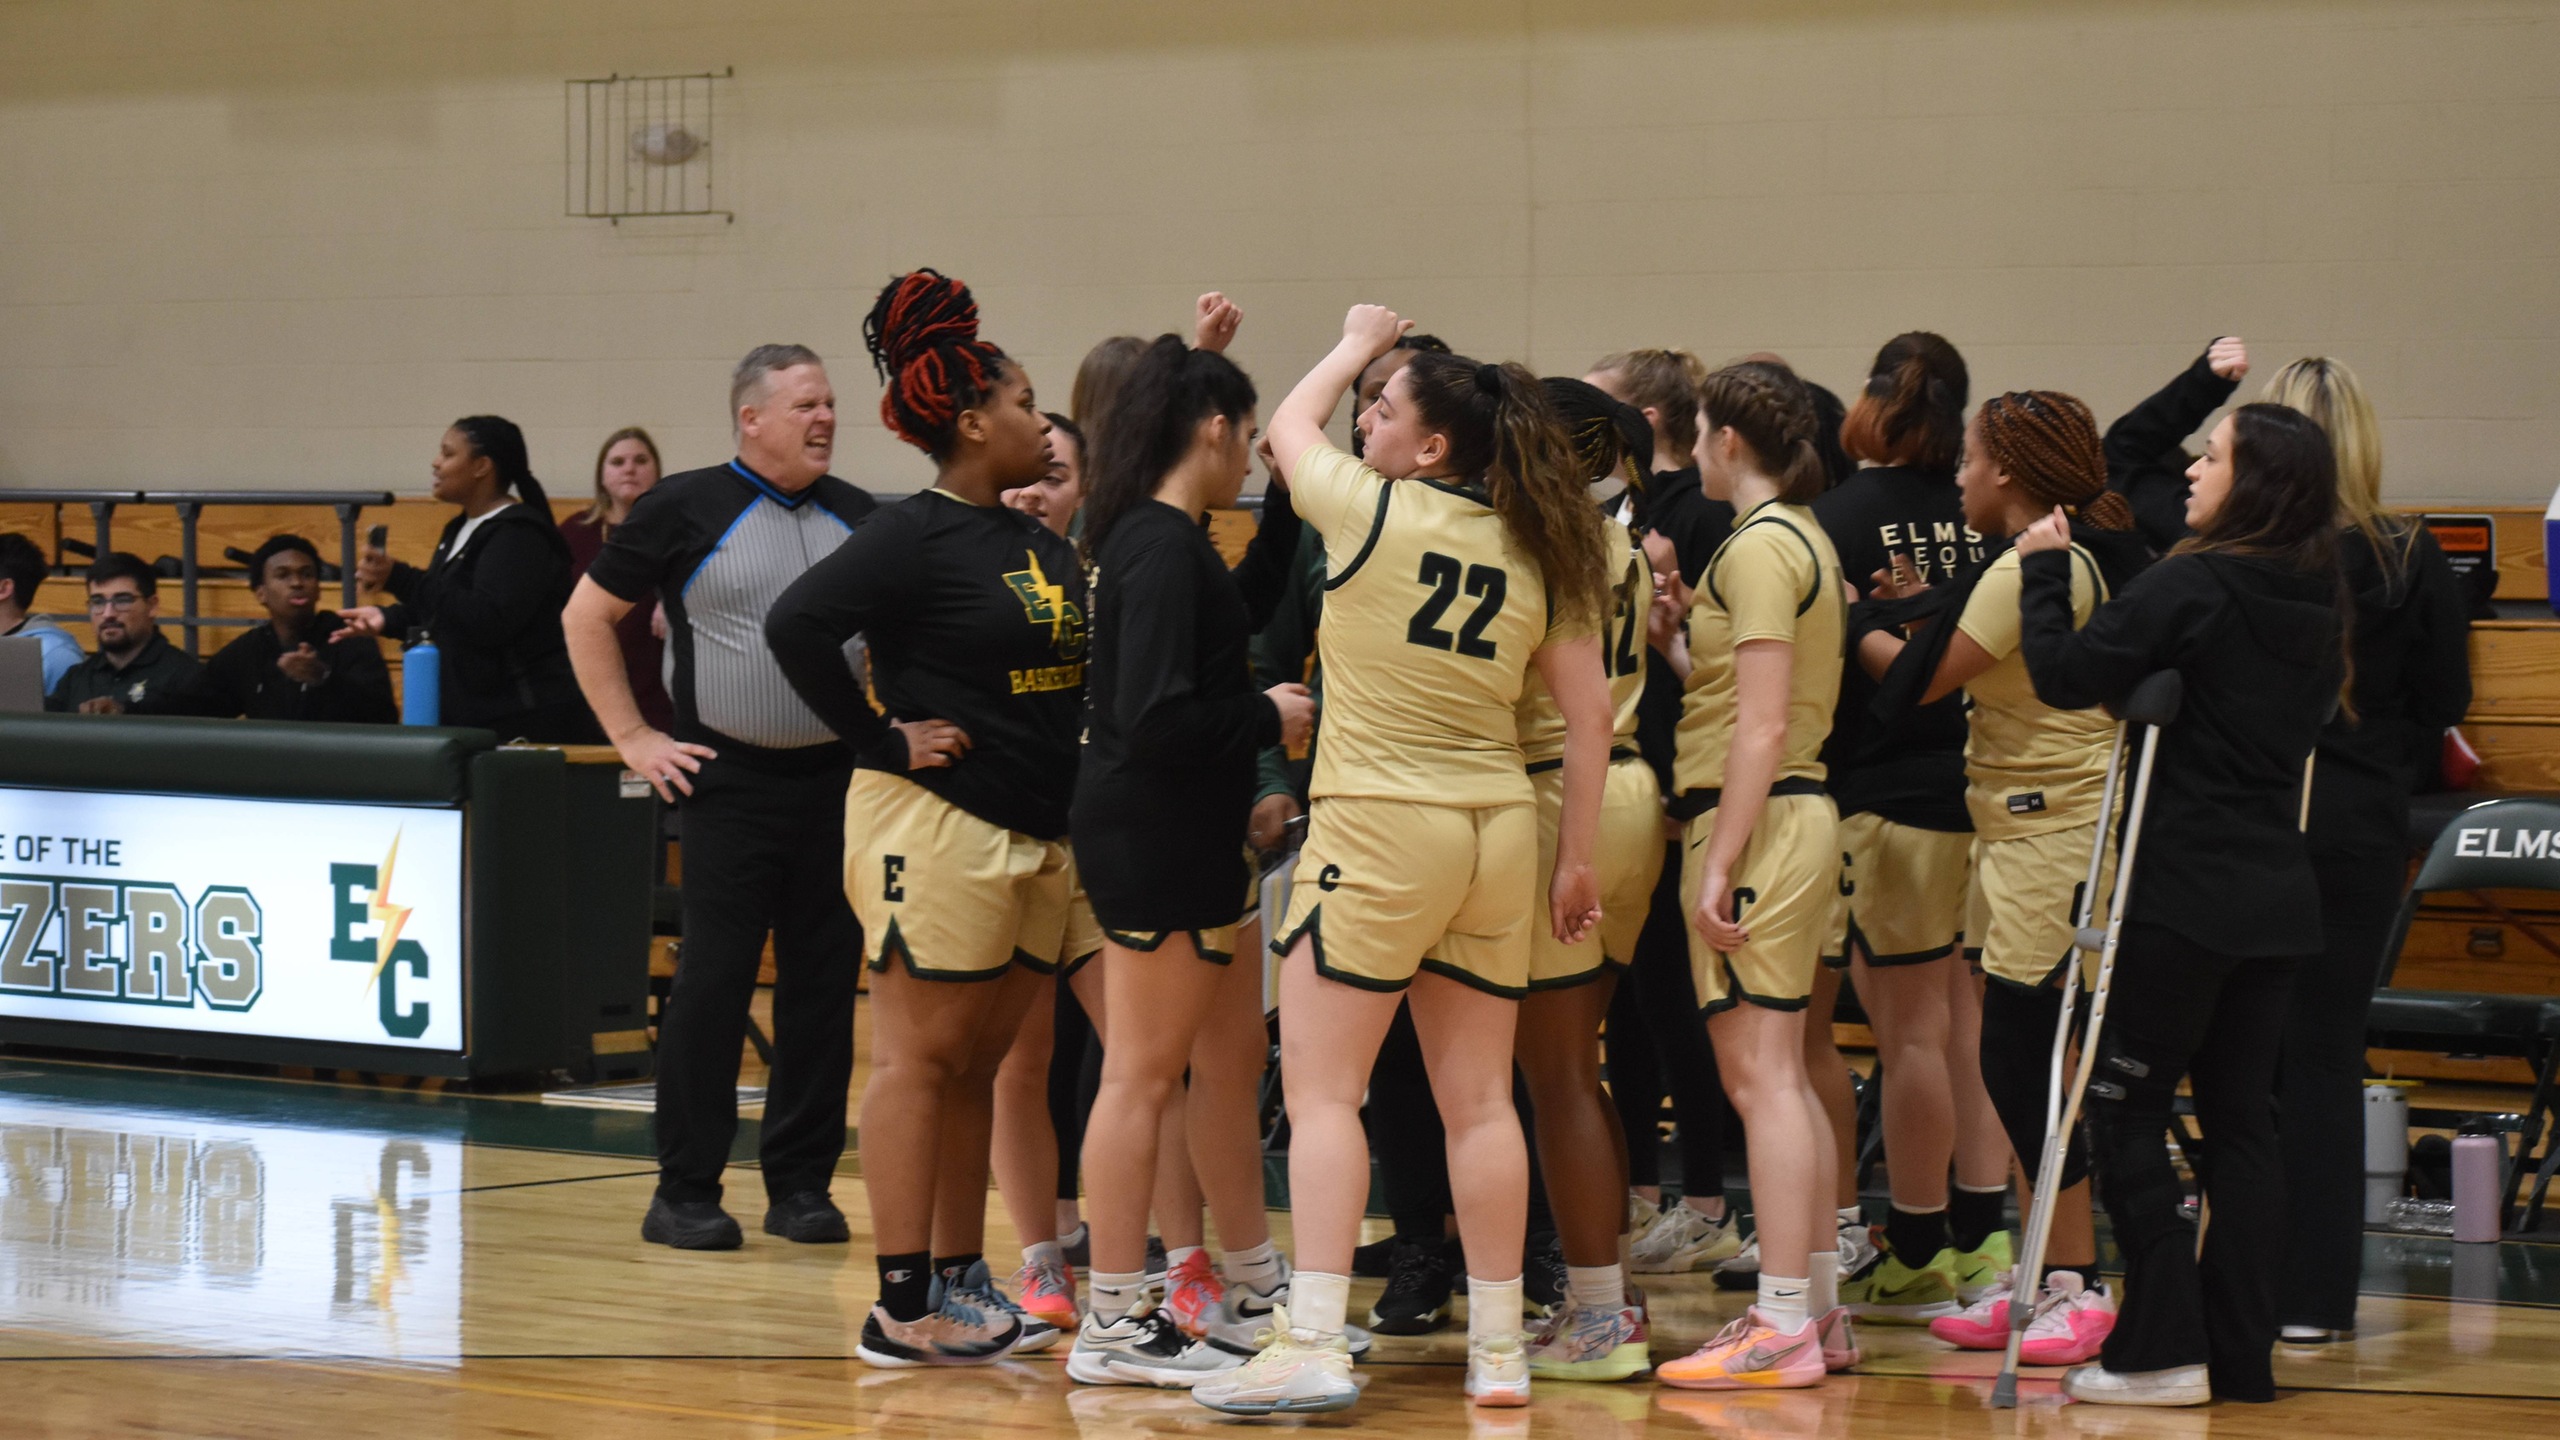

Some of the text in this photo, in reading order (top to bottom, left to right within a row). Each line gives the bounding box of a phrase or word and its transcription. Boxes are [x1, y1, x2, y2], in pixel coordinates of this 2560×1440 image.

[1879, 522, 1983, 546] ELMS
[1406, 551, 1507, 661] 22
[16, 835, 52, 862] OF
[63, 837, 121, 867] THE
[2454, 827, 2560, 859] ELMS
[884, 854, 905, 902] E
[1319, 864, 1341, 893] C
[0, 872, 262, 1012] ZERS
